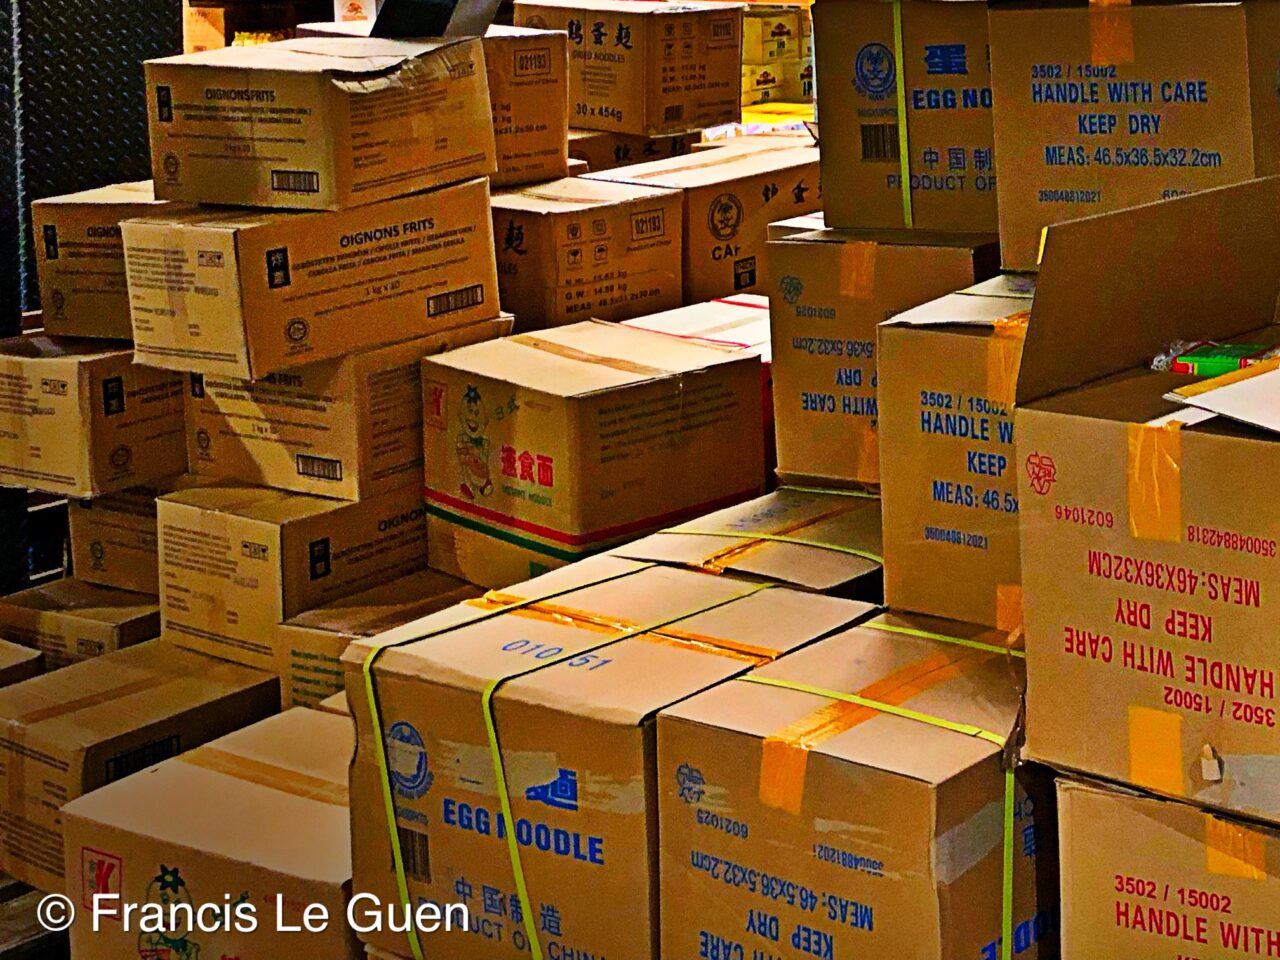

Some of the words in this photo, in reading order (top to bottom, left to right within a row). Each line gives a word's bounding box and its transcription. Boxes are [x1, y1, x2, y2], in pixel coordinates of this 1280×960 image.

[519, 53, 546, 72] 021193
[1031, 63, 1063, 80] 3502
[1076, 62, 1117, 79] 15002
[205, 88, 250, 102] OIGNONS
[251, 90, 276, 103] FRITS
[911, 88, 957, 110] EGG
[1031, 82, 1100, 105] HANDLE
[1106, 82, 1153, 105] WITH
[1160, 80, 1208, 103] CARE
[576, 103, 588, 117] 30
[598, 106, 623, 122] 454g
[1077, 113, 1118, 136] KEEP
[1128, 113, 1161, 136] DRY
[1045, 145, 1091, 168] MEAS:
[1094, 145, 1222, 169] 46.5x36.5x32.2cm
[340, 224, 400, 249] OIGNONS
[403, 217, 435, 236] FRITS
[634, 215, 661, 236] 021193
[835, 368, 862, 387] DRY
[801, 391, 837, 413] CARE
[920, 390, 953, 410] 3502
[920, 409, 990, 442] HANDLE
[966, 450, 1007, 479] KEEP
[932, 480, 979, 509] MEAS:
[1054, 503, 1114, 530] 6021046
[1186, 523, 1277, 559] 350048842318
[1115, 596, 1152, 631] DRY
[1165, 613, 1213, 644] KEEP
[502, 639, 614, 671] 01051
[1064, 626, 1113, 664] CARE
[1122, 642, 1175, 679] WITH
[1185, 654, 1275, 700] HANDLE
[1164, 686, 1214, 714] 15002
[1233, 700, 1276, 729] 3502
[443, 797, 491, 838] EGG
[696, 808, 749, 838] 6021025
[690, 850, 818, 911] 46.5x36.5x32.2cm
[821, 895, 874, 932] MEAS:
[1115, 874, 1157, 899] 3502
[1177, 886, 1232, 913] 15002
[746, 908, 781, 942] DRY
[791, 922, 834, 959] KEEP
[1114, 901, 1208, 947] HANDLE
